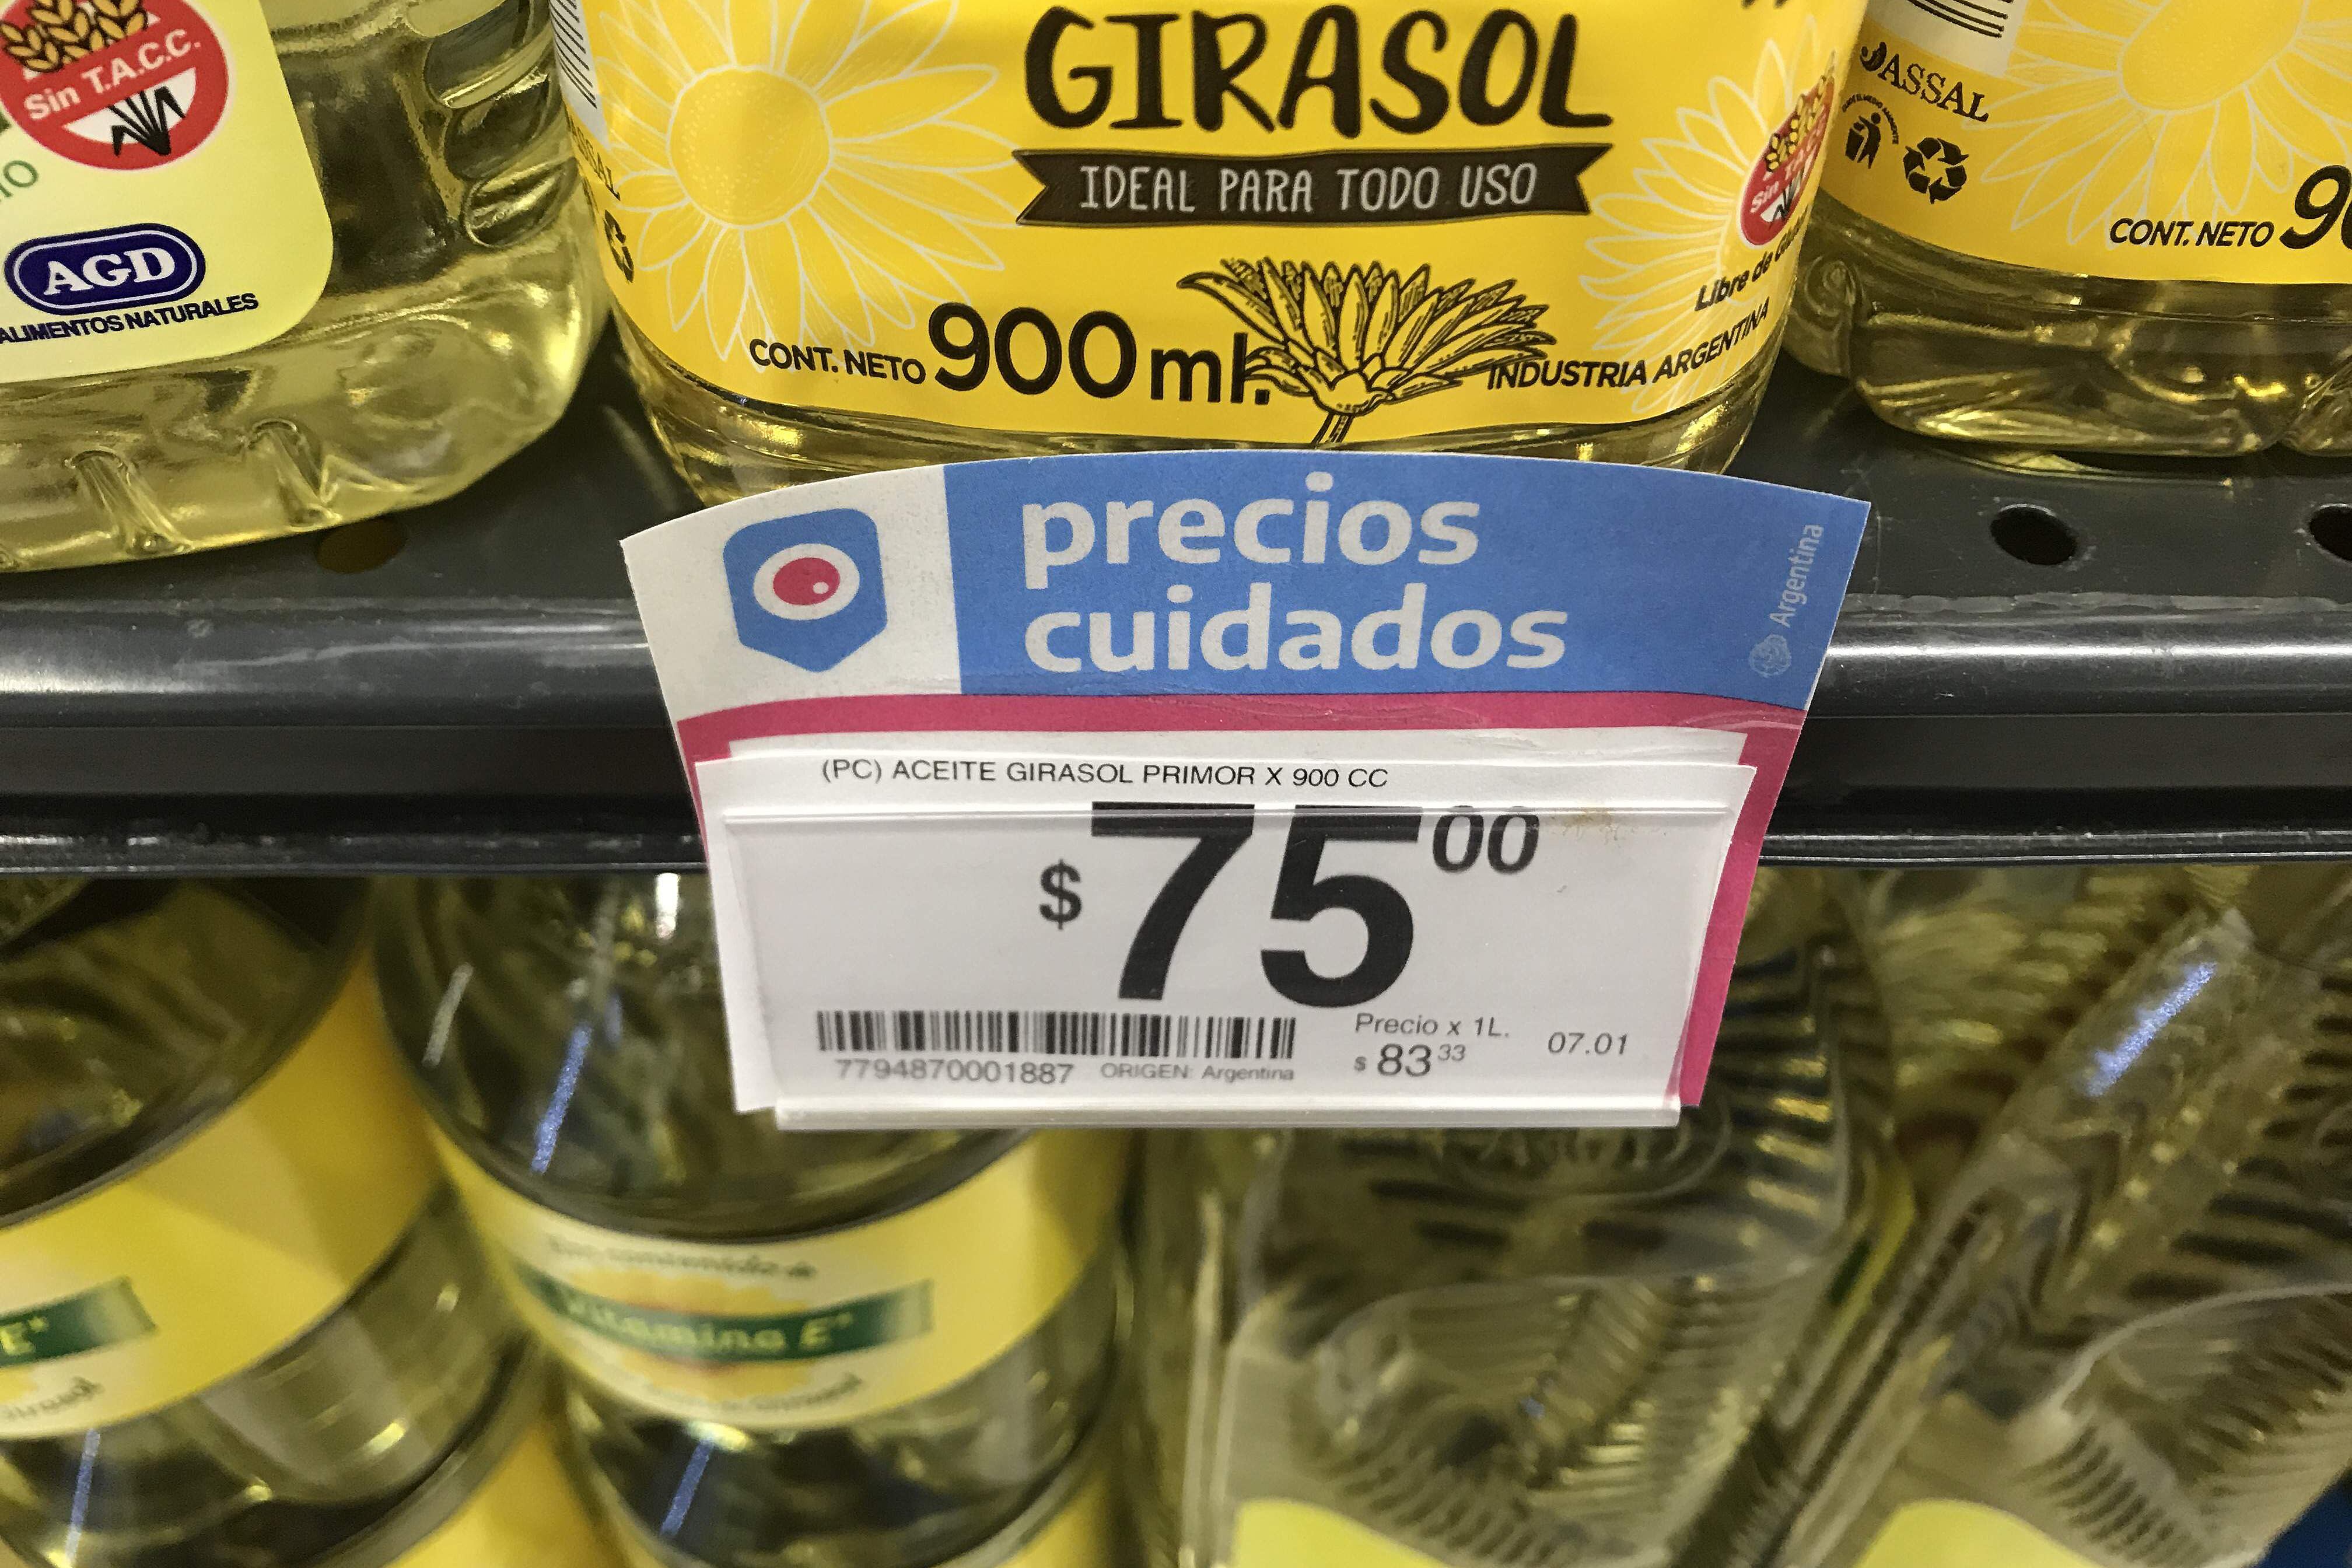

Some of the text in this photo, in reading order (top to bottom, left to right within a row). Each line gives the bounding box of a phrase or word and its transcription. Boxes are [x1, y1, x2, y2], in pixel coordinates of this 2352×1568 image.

[23, 29, 201, 120] Sin T.A.C.C.
[1024, 5, 1613, 139] GIRASOL
[1080, 162, 1537, 212] IDEAL PARA TODO USO
[1749, 180, 1779, 214] Sin
[2110, 218, 2194, 246] CONT.
[2196, 220, 2274, 247] NETO
[44, 247, 176, 295] AGD
[1695, 251, 1774, 312] Libre de
[0, 293, 259, 344] ALIMENTOS NATURALES
[1488, 296, 1770, 390] INDUSTRIA ARGENTINA
[750, 338, 838, 372] CONT.
[843, 348, 926, 384] NETO
[1023, 471, 1480, 589] precios
[1769, 524, 1825, 628] Argentina
[1025, 582, 1568, 674] cuidados
[822, 759, 1388, 788] (PC) ACEITE GIRASOL PRIMOR X 900 CC
[1039, 858, 1082, 931] $
[1091, 801, 1422, 1008] 75
[1355, 1012, 1510, 1037] Precio x 1L.
[1548, 1031, 1629, 1056] 07.01
[835, 1059, 1074, 1084] 7794870001887
[1200, 1065, 1294, 1083] Argentina
[1377, 1043, 1432, 1077] 83
